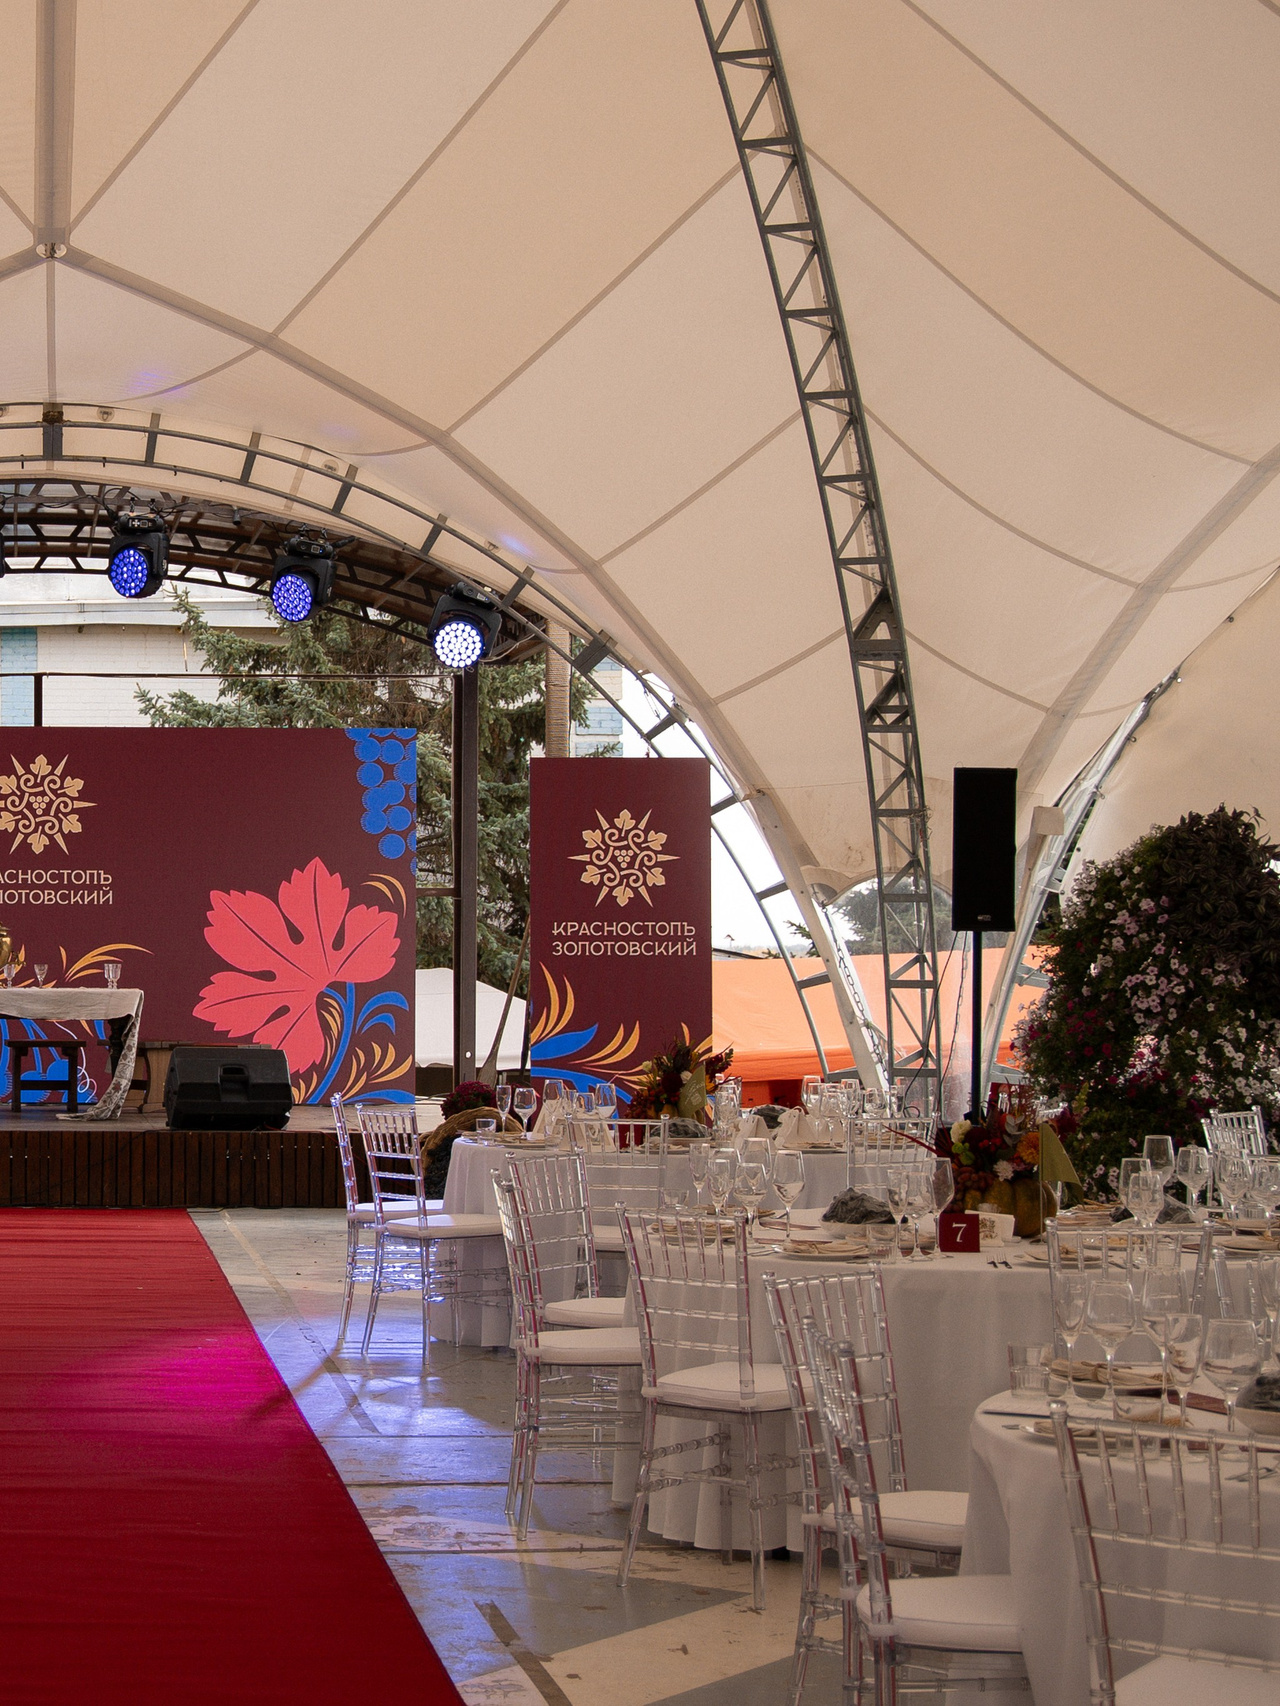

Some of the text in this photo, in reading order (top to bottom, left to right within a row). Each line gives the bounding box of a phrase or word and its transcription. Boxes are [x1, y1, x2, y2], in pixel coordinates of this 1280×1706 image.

[552, 921, 696, 936] КРАСНОСТОПЪ
[552, 937, 697, 956] ЗОЛОТОВСКИЙ
[952, 1222, 967, 1242] 7
